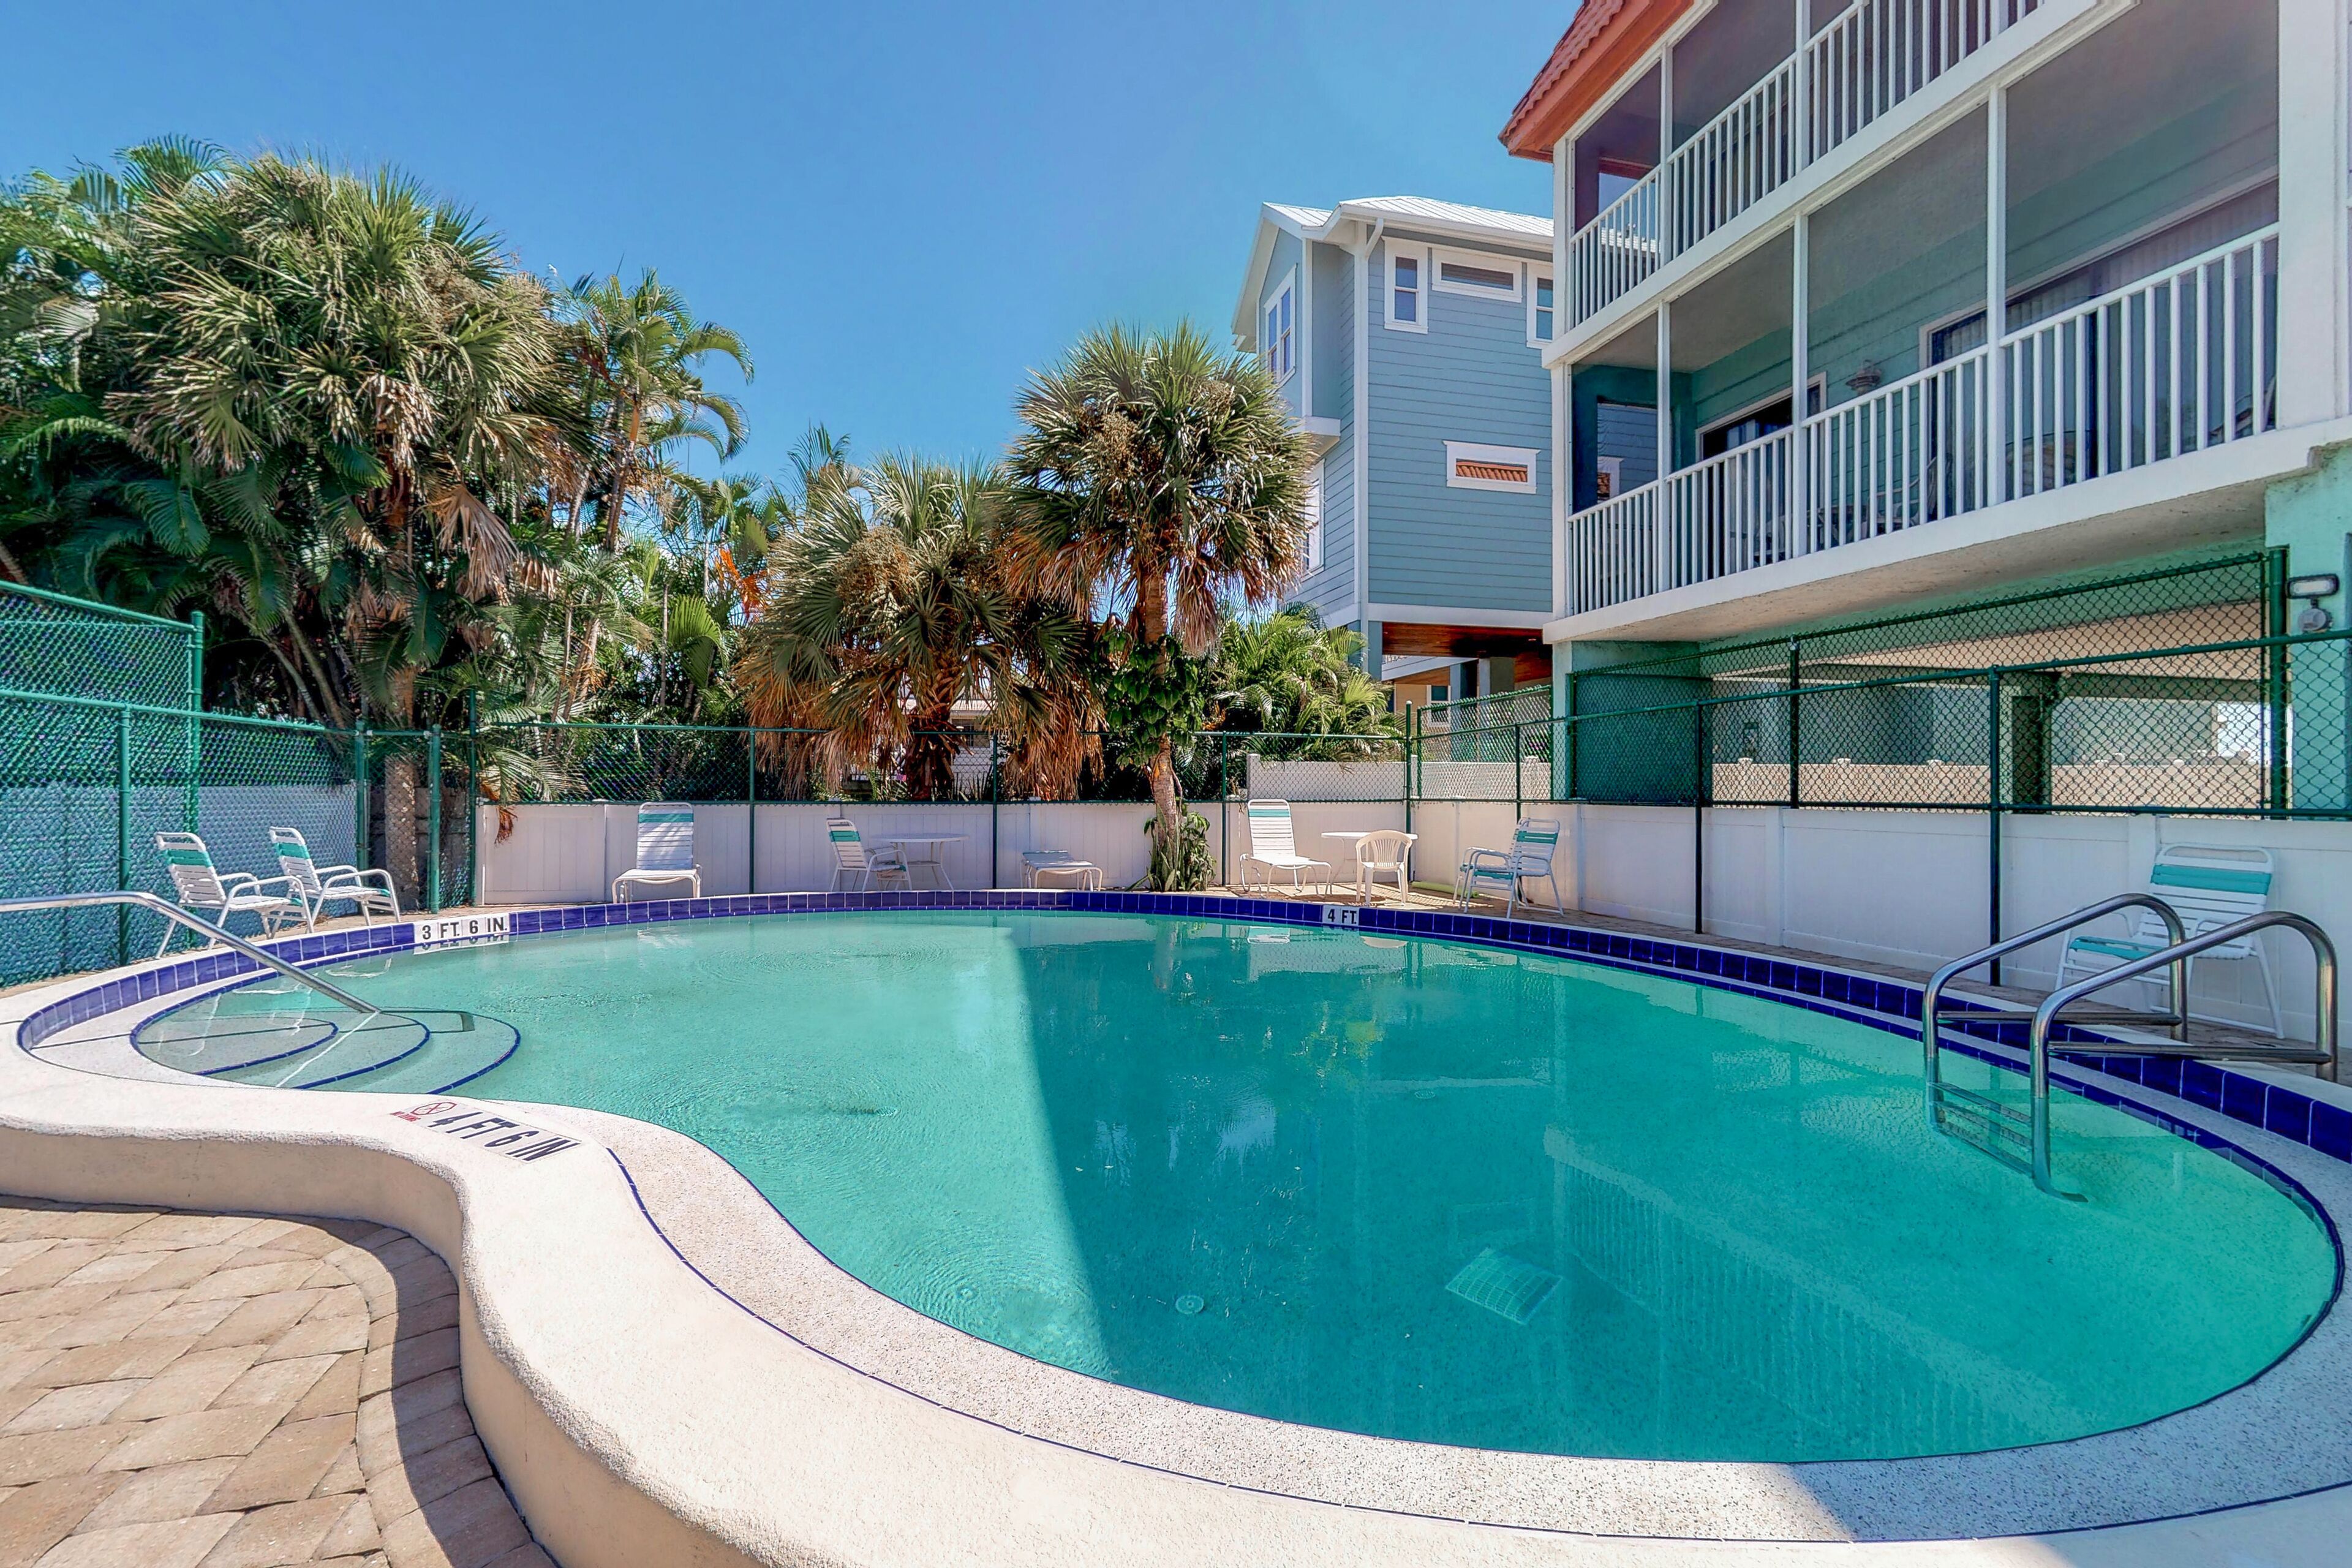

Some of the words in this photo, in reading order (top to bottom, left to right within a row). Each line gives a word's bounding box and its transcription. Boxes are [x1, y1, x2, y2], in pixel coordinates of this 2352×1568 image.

[1328, 909, 1335, 922] 4
[422, 925, 431, 940] 3
[441, 922, 459, 938] FT.
[469, 920, 478, 934] 6
[488, 916, 507, 932] IN.
[428, 1112, 483, 1128] 4
[445, 1117, 520, 1139] FT
[484, 1130, 540, 1148] 6
[505, 1137, 581, 1161] IN
